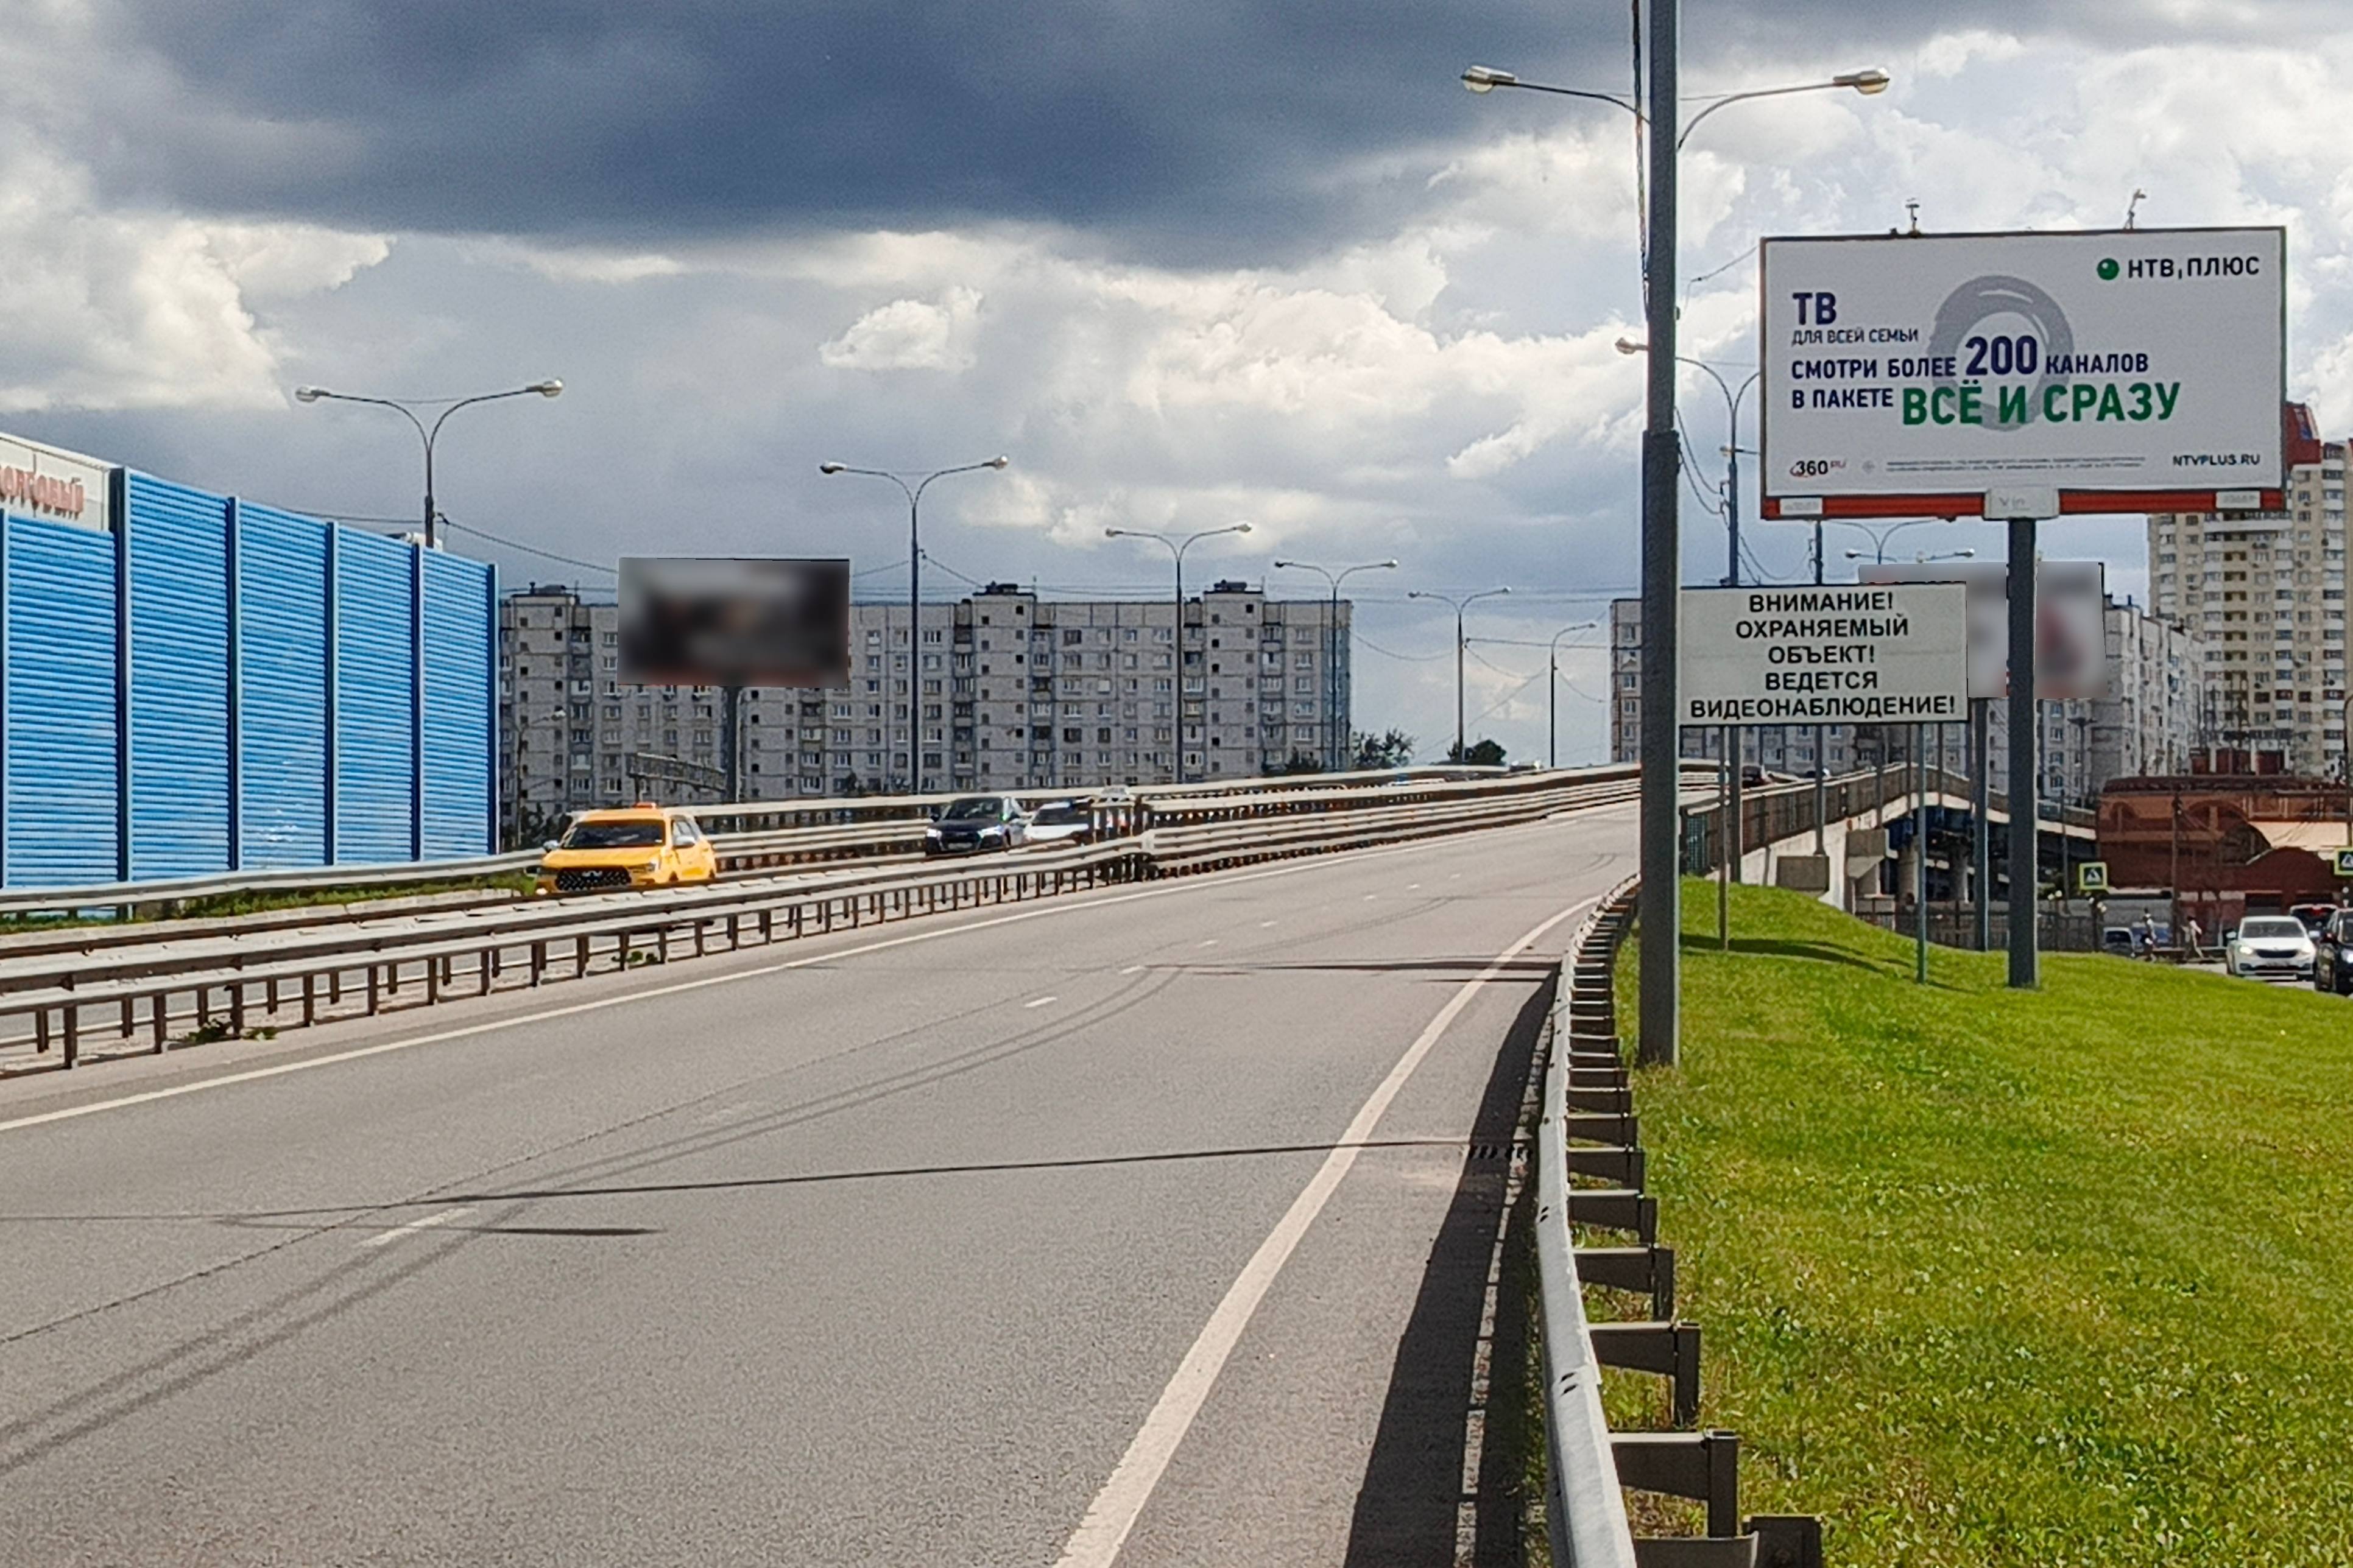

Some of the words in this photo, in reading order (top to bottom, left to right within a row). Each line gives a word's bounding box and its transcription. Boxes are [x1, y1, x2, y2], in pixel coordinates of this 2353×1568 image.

[1792, 292, 1837, 325] ТВ
[1791, 329, 1824, 346] ДЛЯ
[1827, 327, 1865, 343] ВСЕЙ
[1868, 328, 1919, 343] СЕМЬИ
[1791, 359, 1878, 379] СМОТРИ
[1887, 357, 1957, 378] БОЛЕЕ
[1964, 335, 2038, 376] 200
[2045, 353, 2149, 374] КАНАЛОВ
[1791, 389, 1805, 409] В
[1812, 388, 1894, 408] ПАКЕТЕ
[1902, 379, 1983, 425] ВСЁ
[1998, 385, 2027, 424] И
[2043, 382, 2181, 423] СРАЗУ
[2172, 454, 2261, 466] NTVPLUS.RU
[0, 465, 84, 513] ОРГОВЫЙ
[1749, 591, 1894, 613] ВНИМАНИЕ!
[1735, 613, 1908, 639] ОХРАНЯЕМЫЙ
[1768, 644, 1875, 664] ОБЪЕКТ!
[1765, 670, 1878, 694] ВЕДЕТСЯ
[1690, 695, 1955, 720] ВИДЕОНАБЛЮДЕНИЕ!
